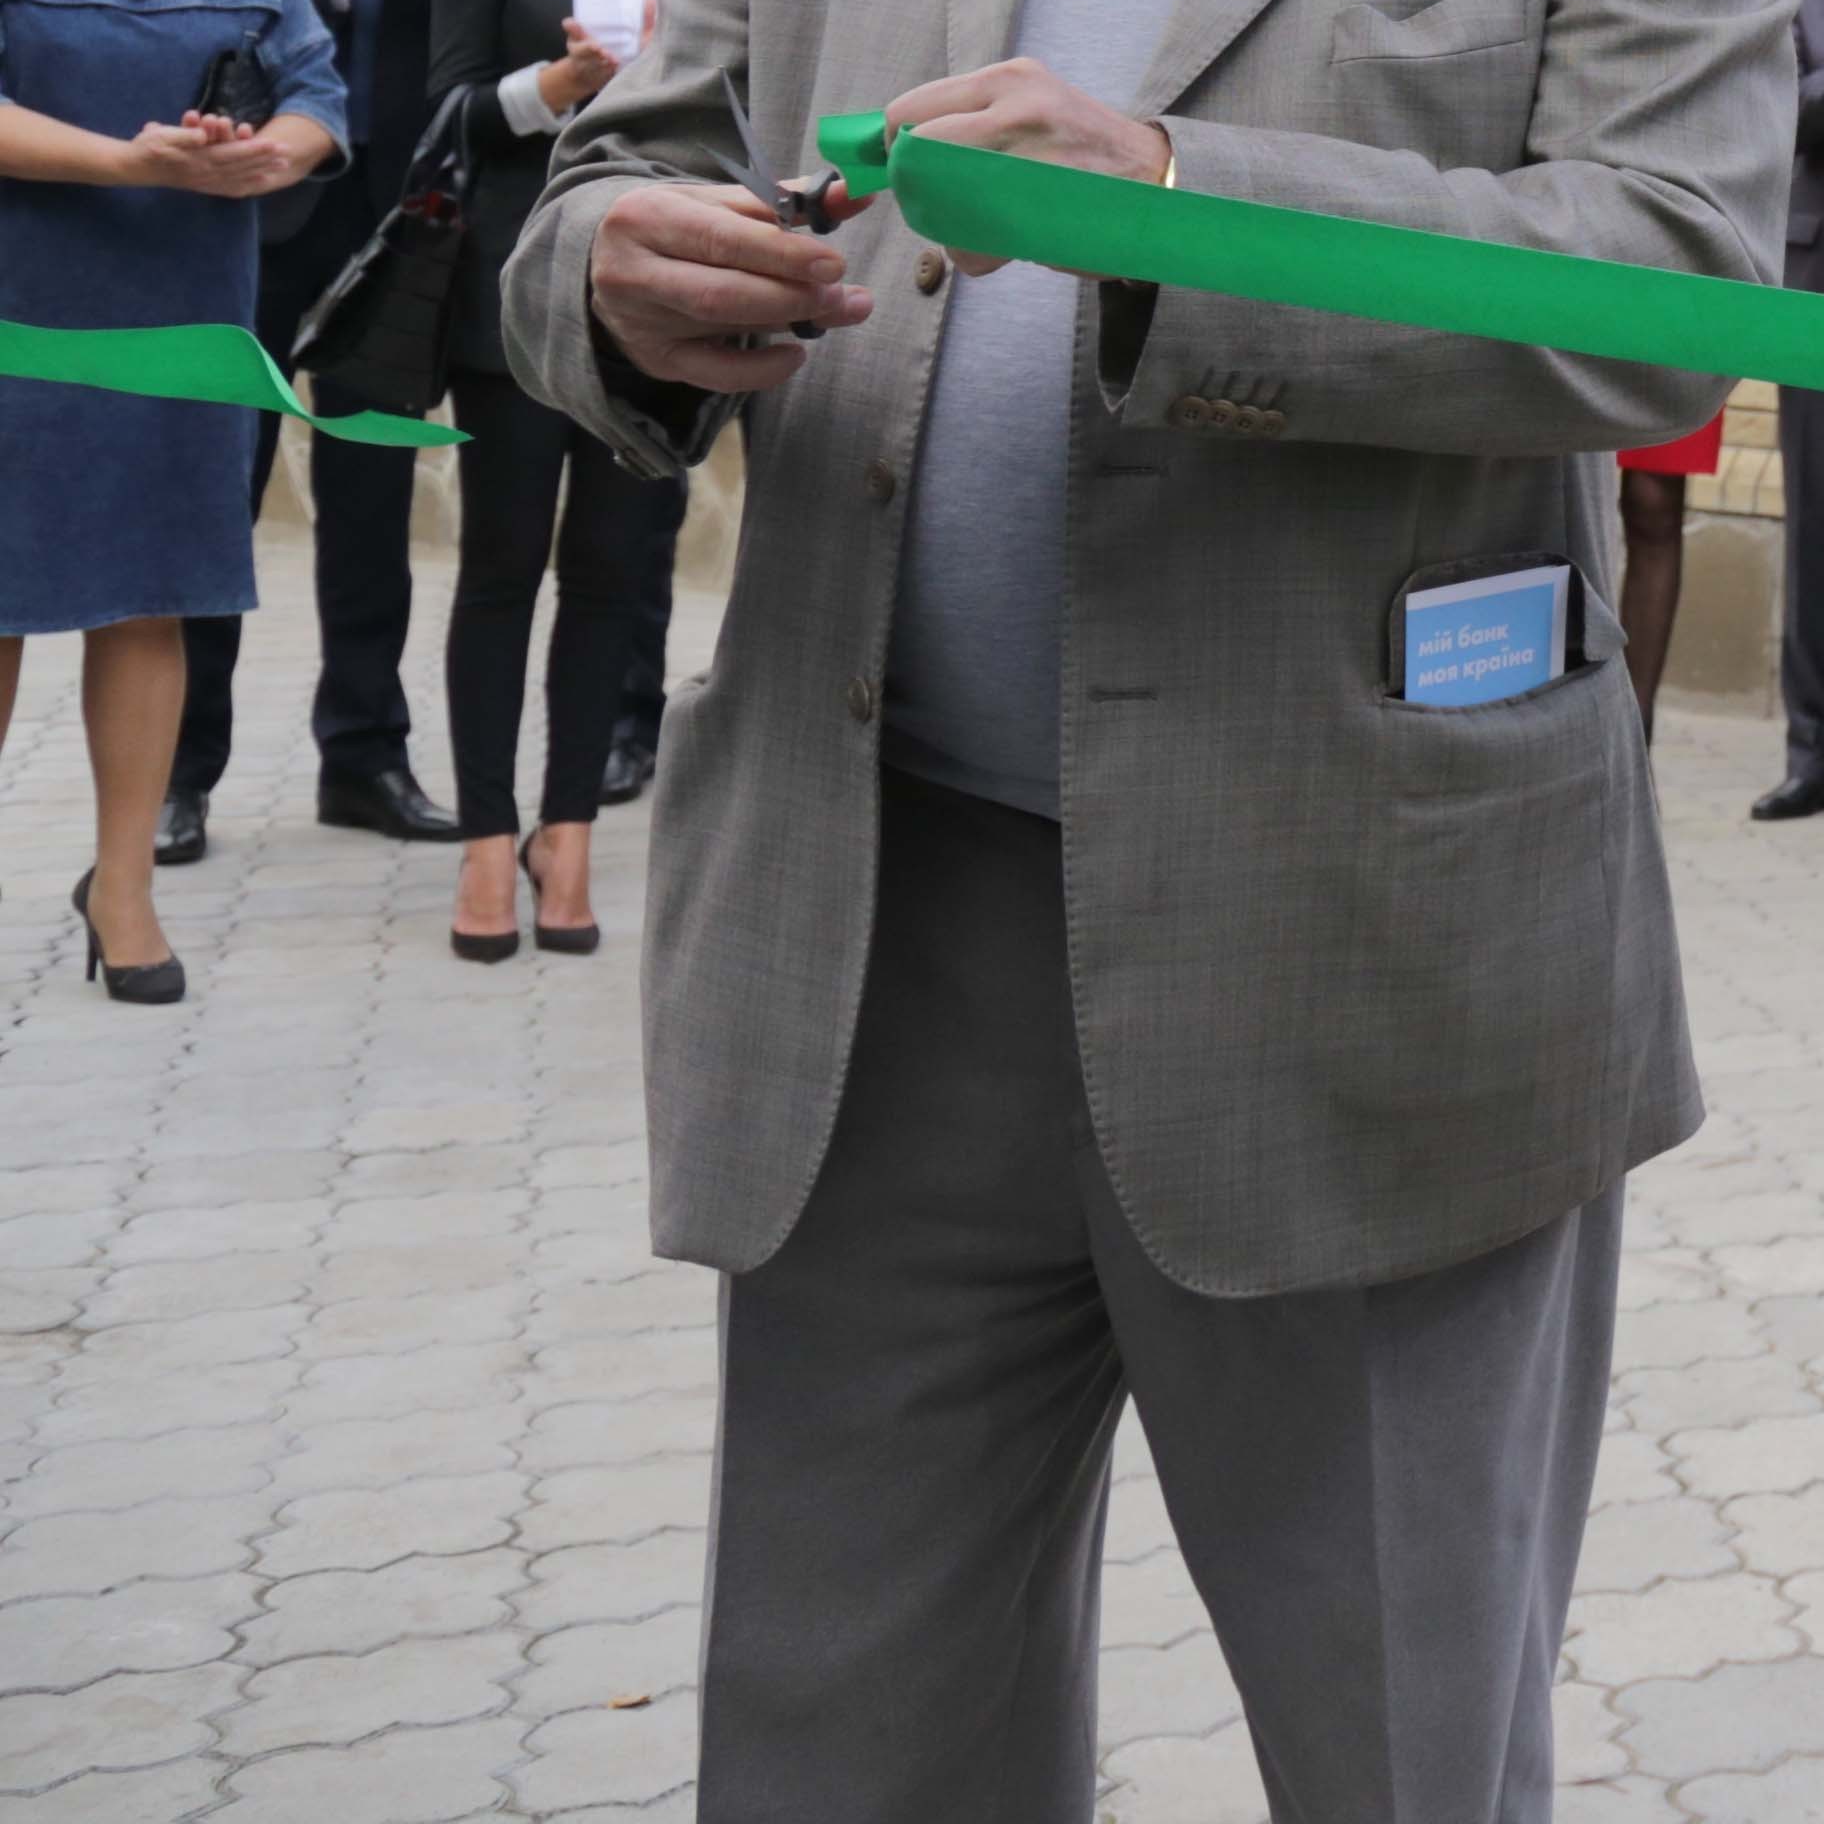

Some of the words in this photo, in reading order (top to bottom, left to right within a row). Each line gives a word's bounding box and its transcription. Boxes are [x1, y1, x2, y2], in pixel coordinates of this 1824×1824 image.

[1419, 631, 1453, 656] мій
[1458, 624, 1509, 647] банк
[1418, 663, 1458, 687] моя
[1463, 647, 1535, 680] країна
